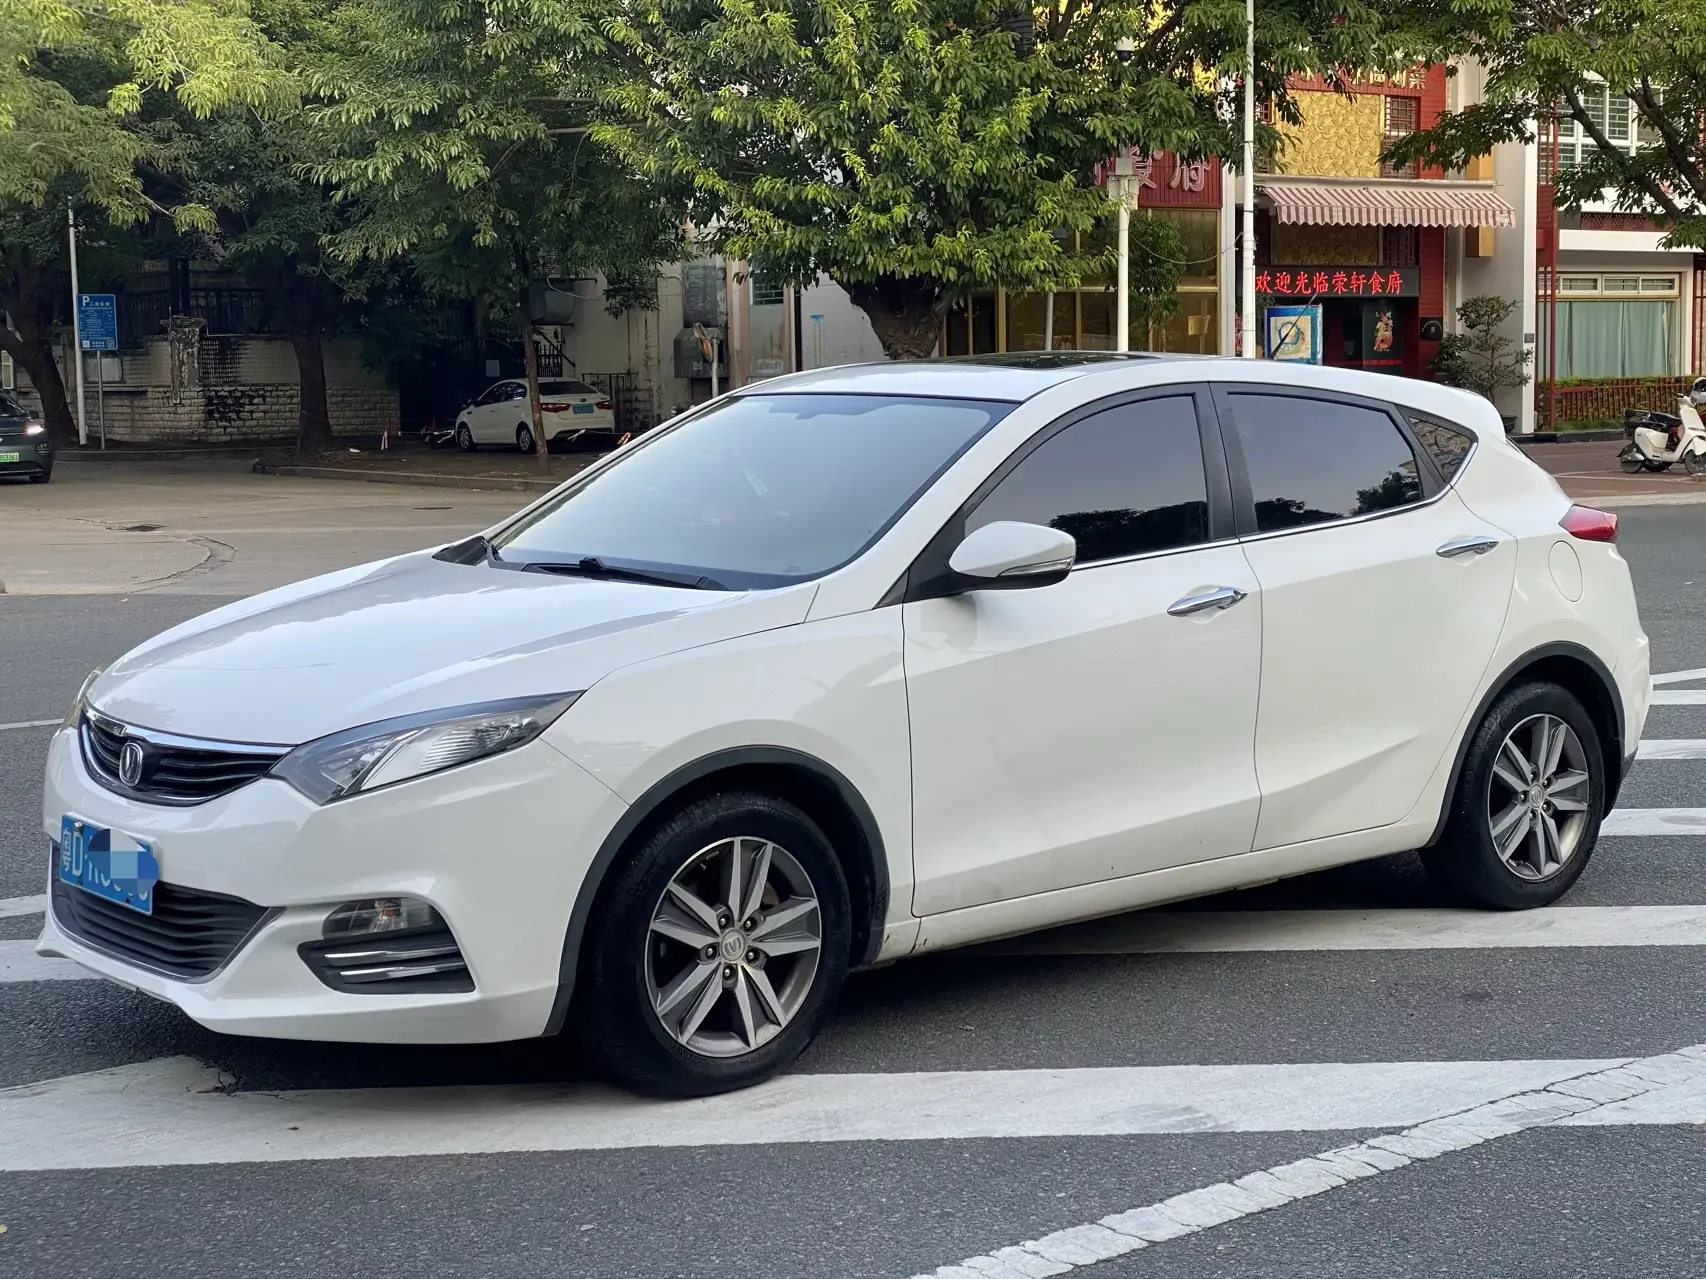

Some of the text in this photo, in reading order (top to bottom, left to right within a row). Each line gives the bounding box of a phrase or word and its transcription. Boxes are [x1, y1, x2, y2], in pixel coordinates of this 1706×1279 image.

[1256, 270, 1403, 295] 欢迎光临荣轩食府
